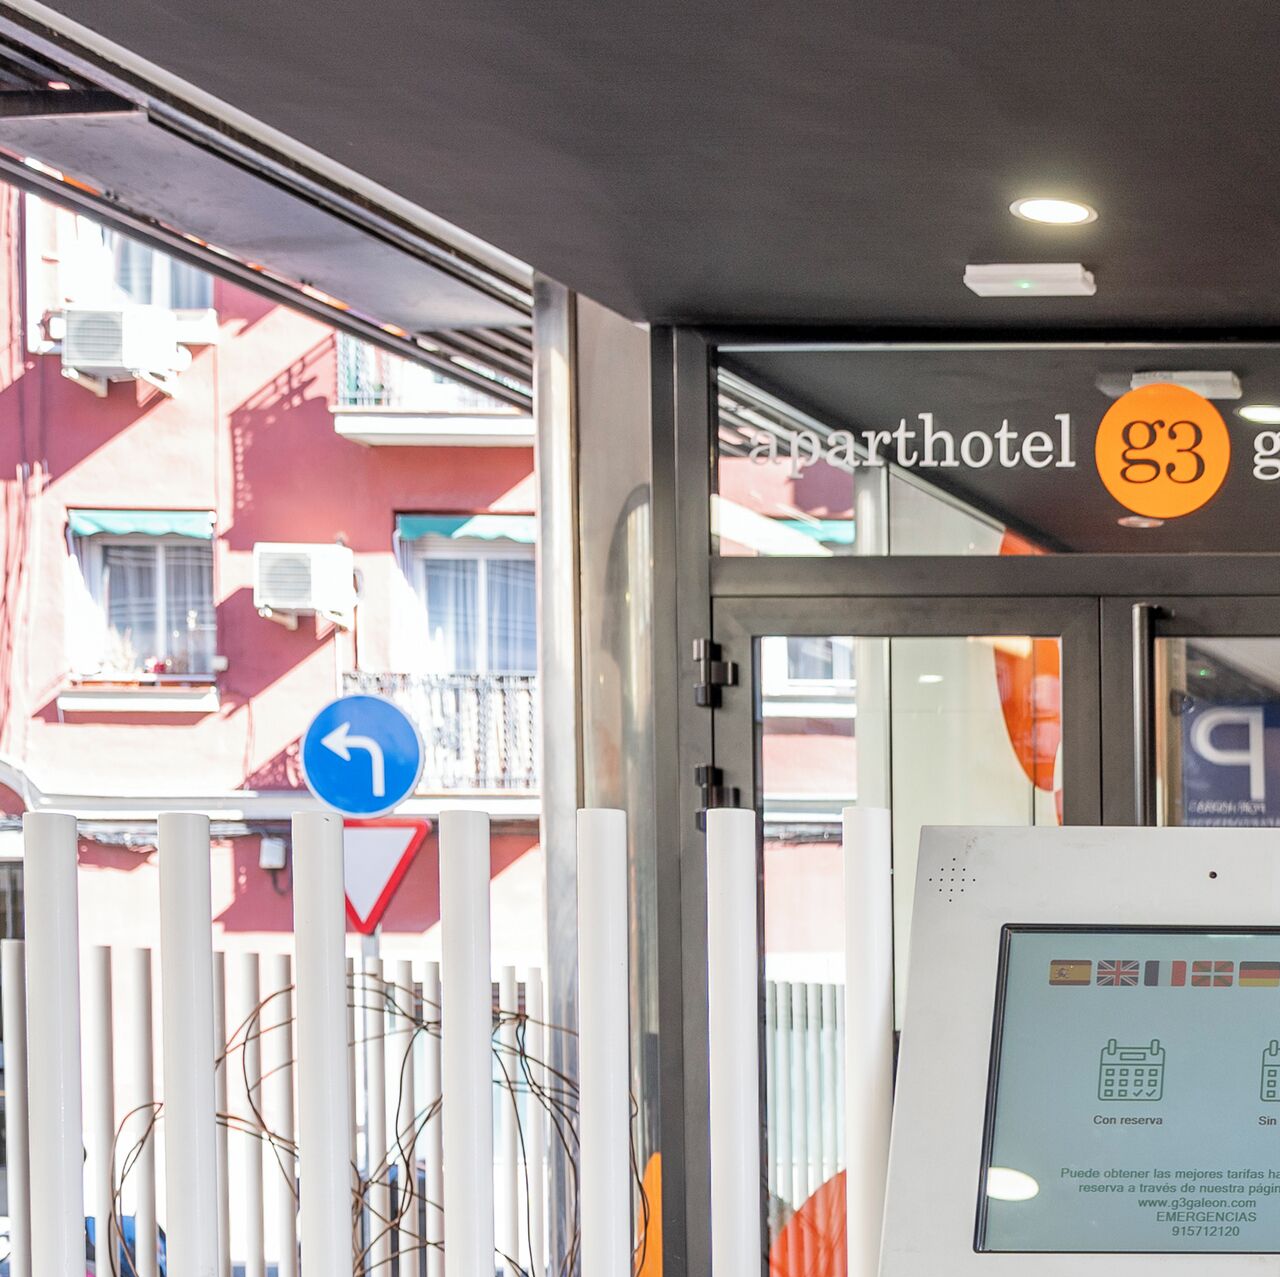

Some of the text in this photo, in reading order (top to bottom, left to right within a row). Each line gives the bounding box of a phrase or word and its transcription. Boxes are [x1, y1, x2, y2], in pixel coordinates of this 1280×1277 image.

[749, 412, 1076, 478] aparthotel
[1119, 419, 1206, 485] g3
[1093, 1114, 1163, 1125] Con reserva
[1258, 1115, 1277, 1126] Sin
[1060, 1168, 1100, 1179] Puede
[1103, 1168, 1150, 1179] obtener
[1153, 1169, 1171, 1179] las
[1175, 1169, 1223, 1182] mejores
[1227, 1169, 1265, 1180] tarifas
[1078, 1184, 1124, 1193] reserva
[1128, 1184, 1136, 1193] a
[1139, 1182, 1177, 1194] través
[1180, 1183, 1195, 1194] de
[1199, 1183, 1245, 1194] nuestra
[1138, 1197, 1257, 1211] www.g3galeon.com
[1156, 1211, 1257, 1223] EMERGENCIAS
[1171, 1226, 1240, 1237] 915712120
